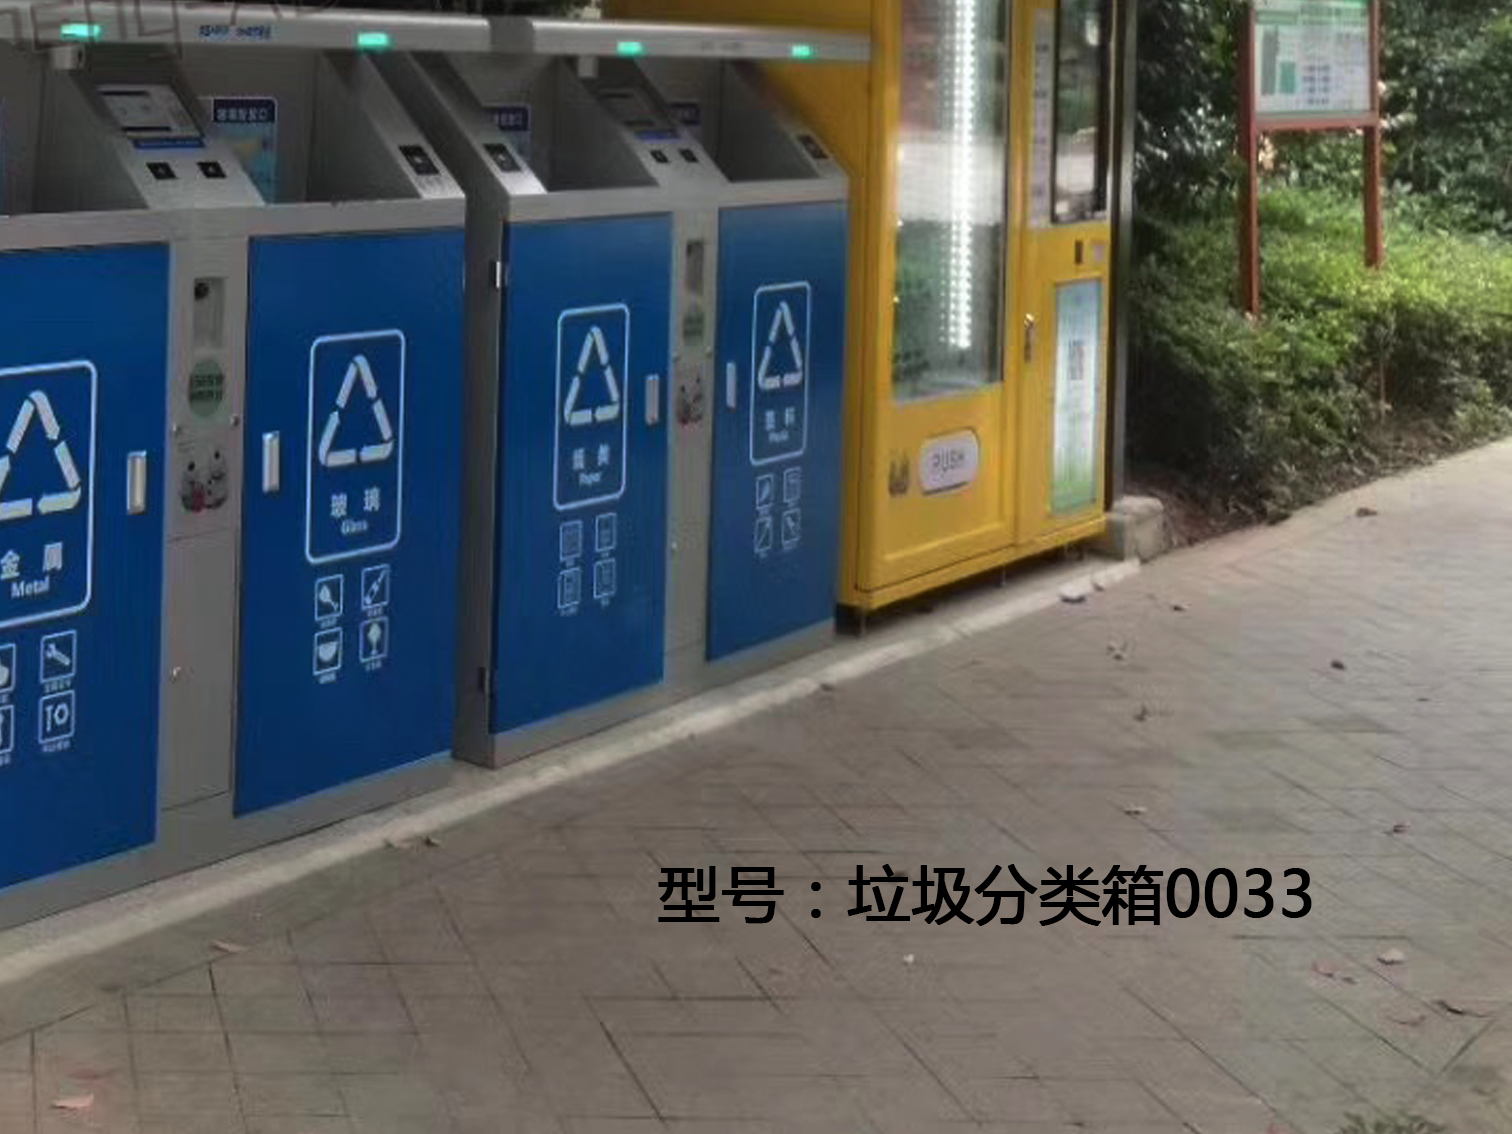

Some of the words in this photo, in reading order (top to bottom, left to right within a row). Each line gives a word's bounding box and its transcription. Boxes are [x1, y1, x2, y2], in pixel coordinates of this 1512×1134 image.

[330, 485, 381, 519] 玻璃
[0, 541, 63, 580] 金属
[10, 575, 50, 600] Metal
